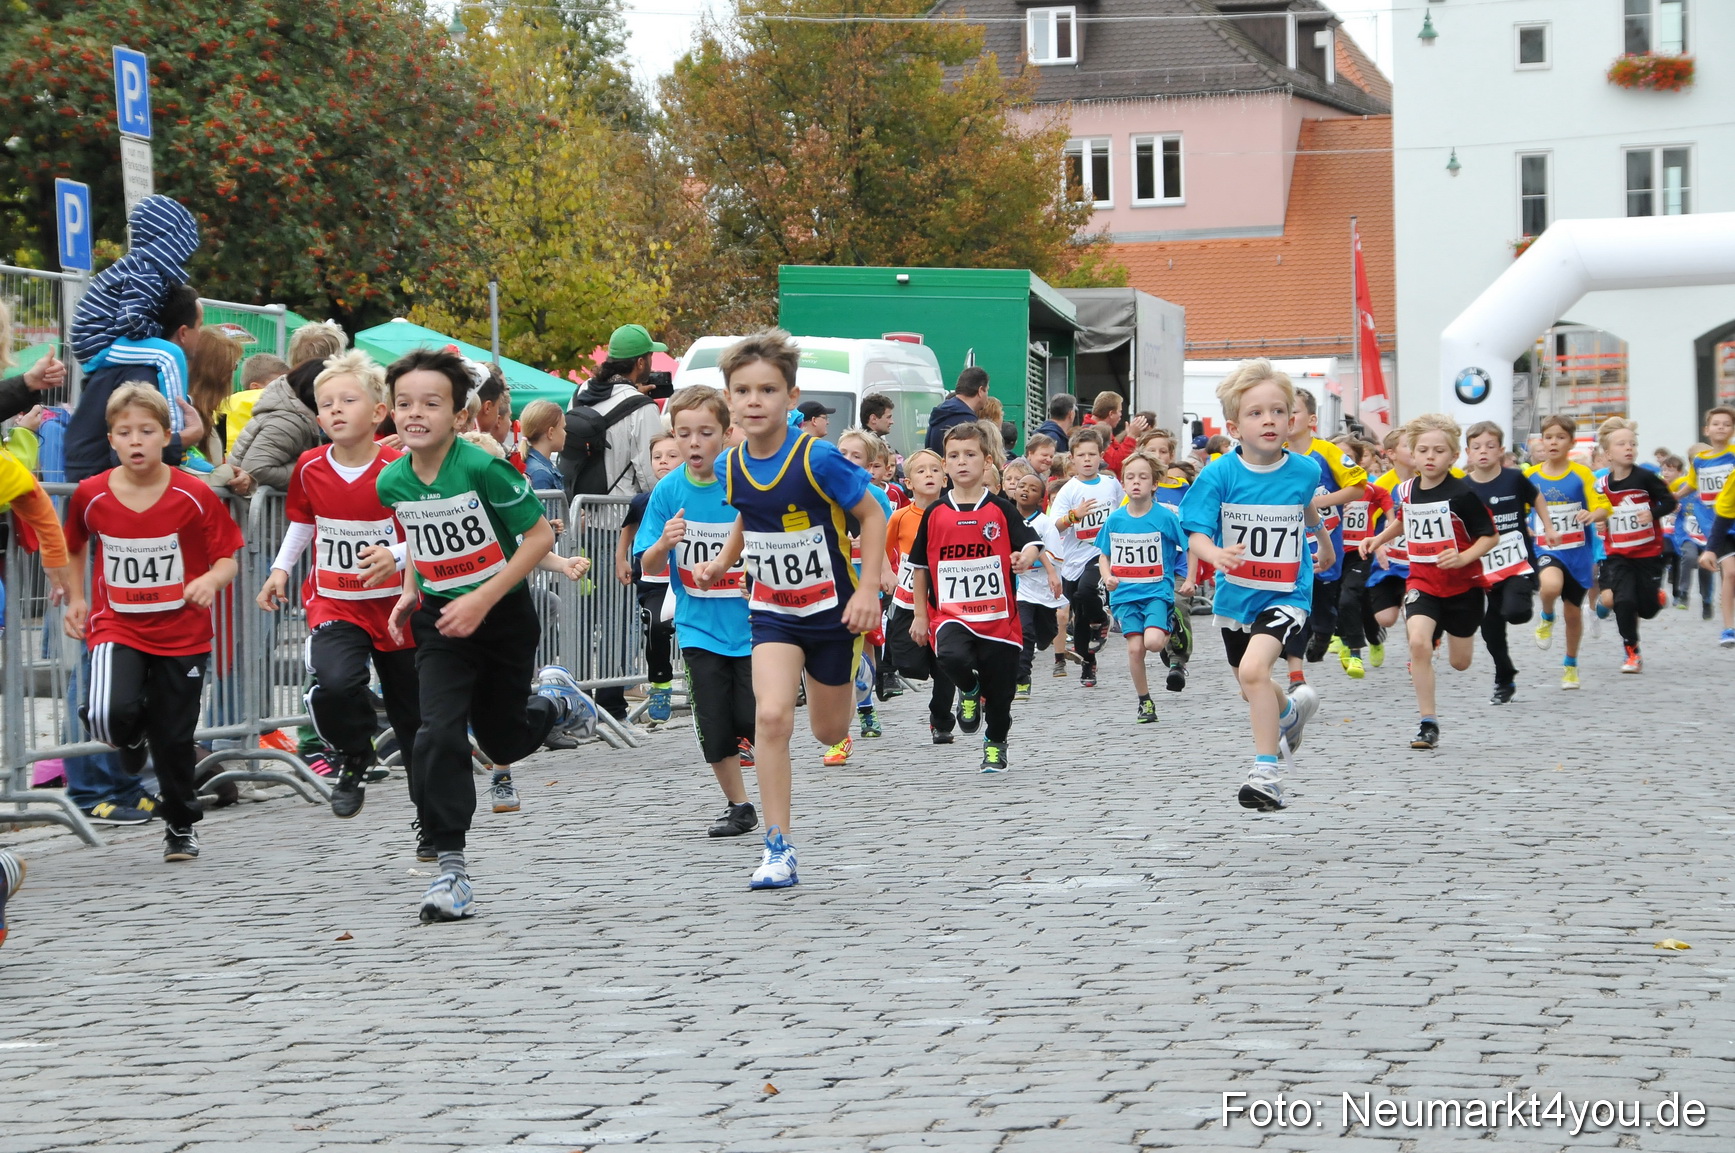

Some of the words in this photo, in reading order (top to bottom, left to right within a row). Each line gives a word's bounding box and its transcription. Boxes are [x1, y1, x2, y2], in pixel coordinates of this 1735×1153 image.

[121, 59, 140, 123] P
[63, 192, 82, 257] P
[1700, 473, 1729, 491] 706
[397, 511, 421, 520] PARTL
[421, 506, 465, 519] Neumarkt
[1223, 510, 1254, 521] PARTL
[1256, 513, 1298, 522] Neumarkt
[1493, 511, 1519, 524] SCHULE
[318, 524, 338, 535] PARTL
[340, 528, 381, 537] Neumarkt
[1546, 514, 1579, 532] 514
[1612, 515, 1649, 531] 718
[407, 515, 486, 556] 7088
[1231, 524, 1299, 558] 7071
[103, 541, 125, 553] PARTL
[126, 544, 168, 554] Neumarkt
[765, 539, 810, 550] Neumarkt
[322, 538, 390, 570] 709
[682, 540, 744, 569] 703
[1115, 545, 1158, 564] 7510
[1482, 543, 1523, 570] 7571
[107, 553, 175, 584] 7047
[433, 561, 475, 578] Marco
[747, 549, 824, 585] 7184
[961, 564, 992, 573] Neumarkt
[1252, 565, 1282, 579] Leon
[945, 572, 1000, 599] 7129
[126, 591, 159, 602] Lukas
[772, 592, 807, 605] Niklas
[962, 604, 988, 614] Aaron
